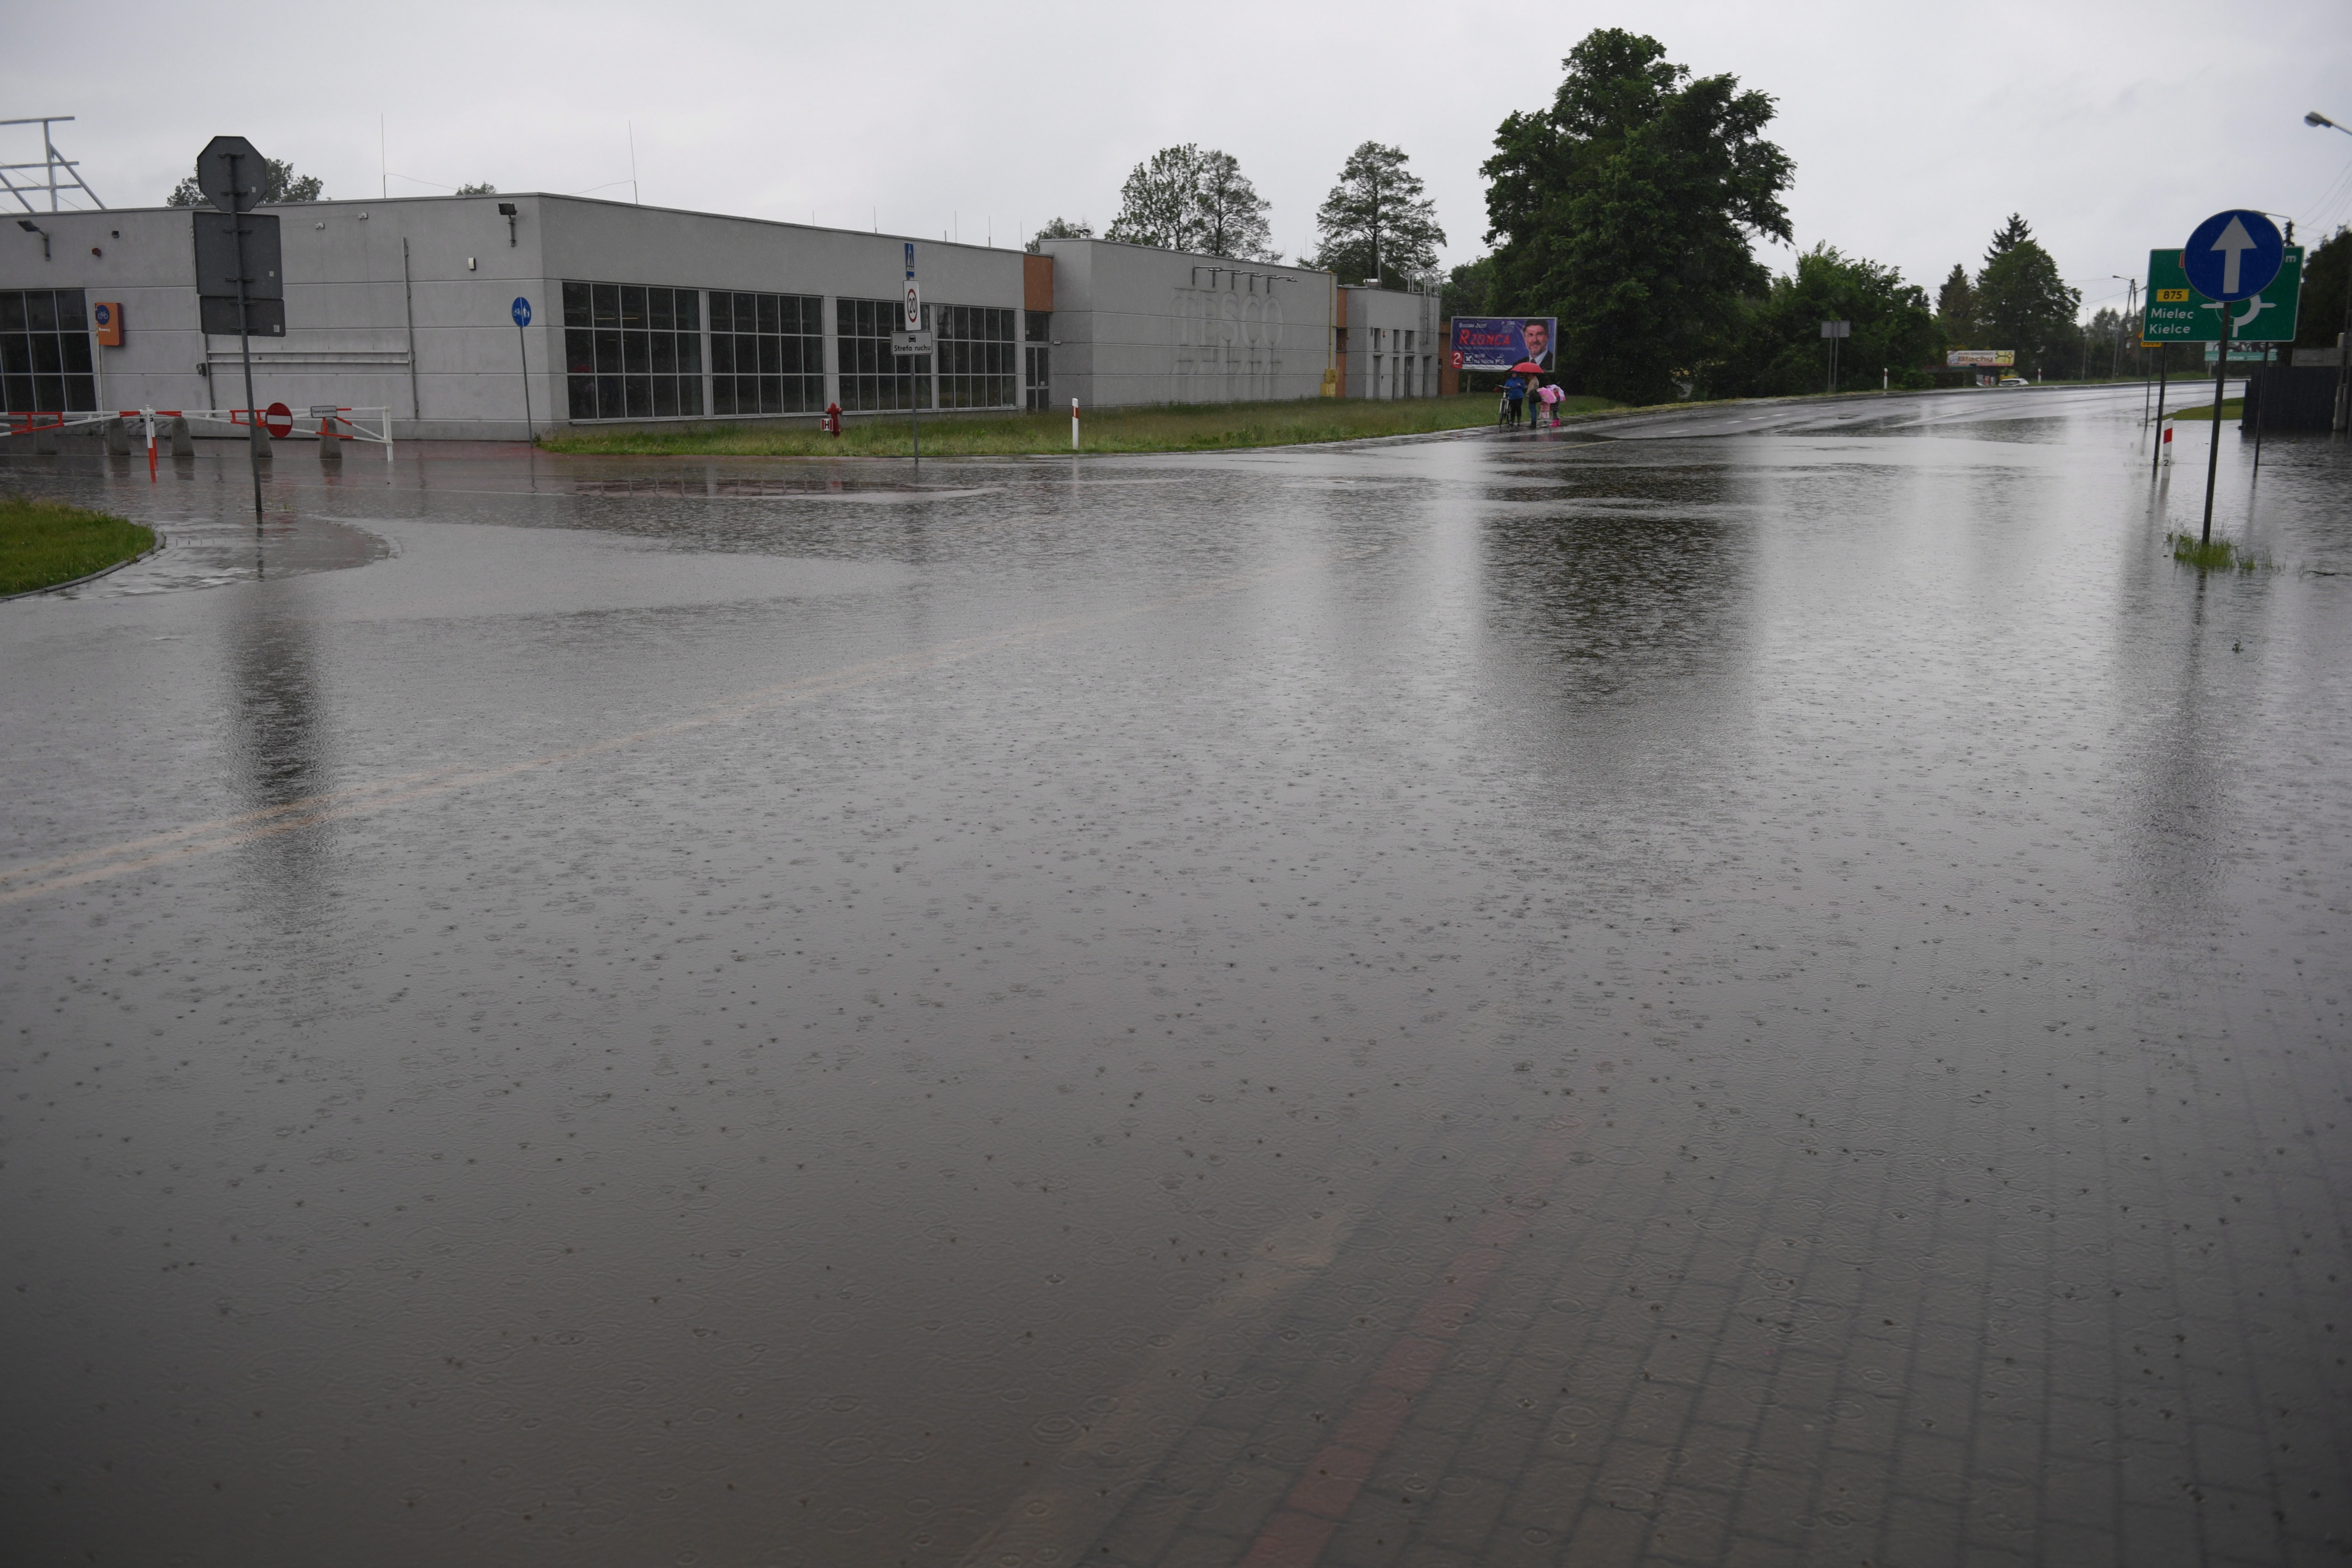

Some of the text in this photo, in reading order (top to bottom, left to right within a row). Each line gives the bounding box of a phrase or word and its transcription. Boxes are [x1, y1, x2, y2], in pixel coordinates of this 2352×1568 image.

[2163, 291, 2182, 299] 875
[909, 297, 916, 313] 20
[2151, 308, 2194, 319] Mielec
[2149, 324, 2190, 334] Kielce
[1453, 353, 1461, 365] 2
[825, 420, 829, 429] H
